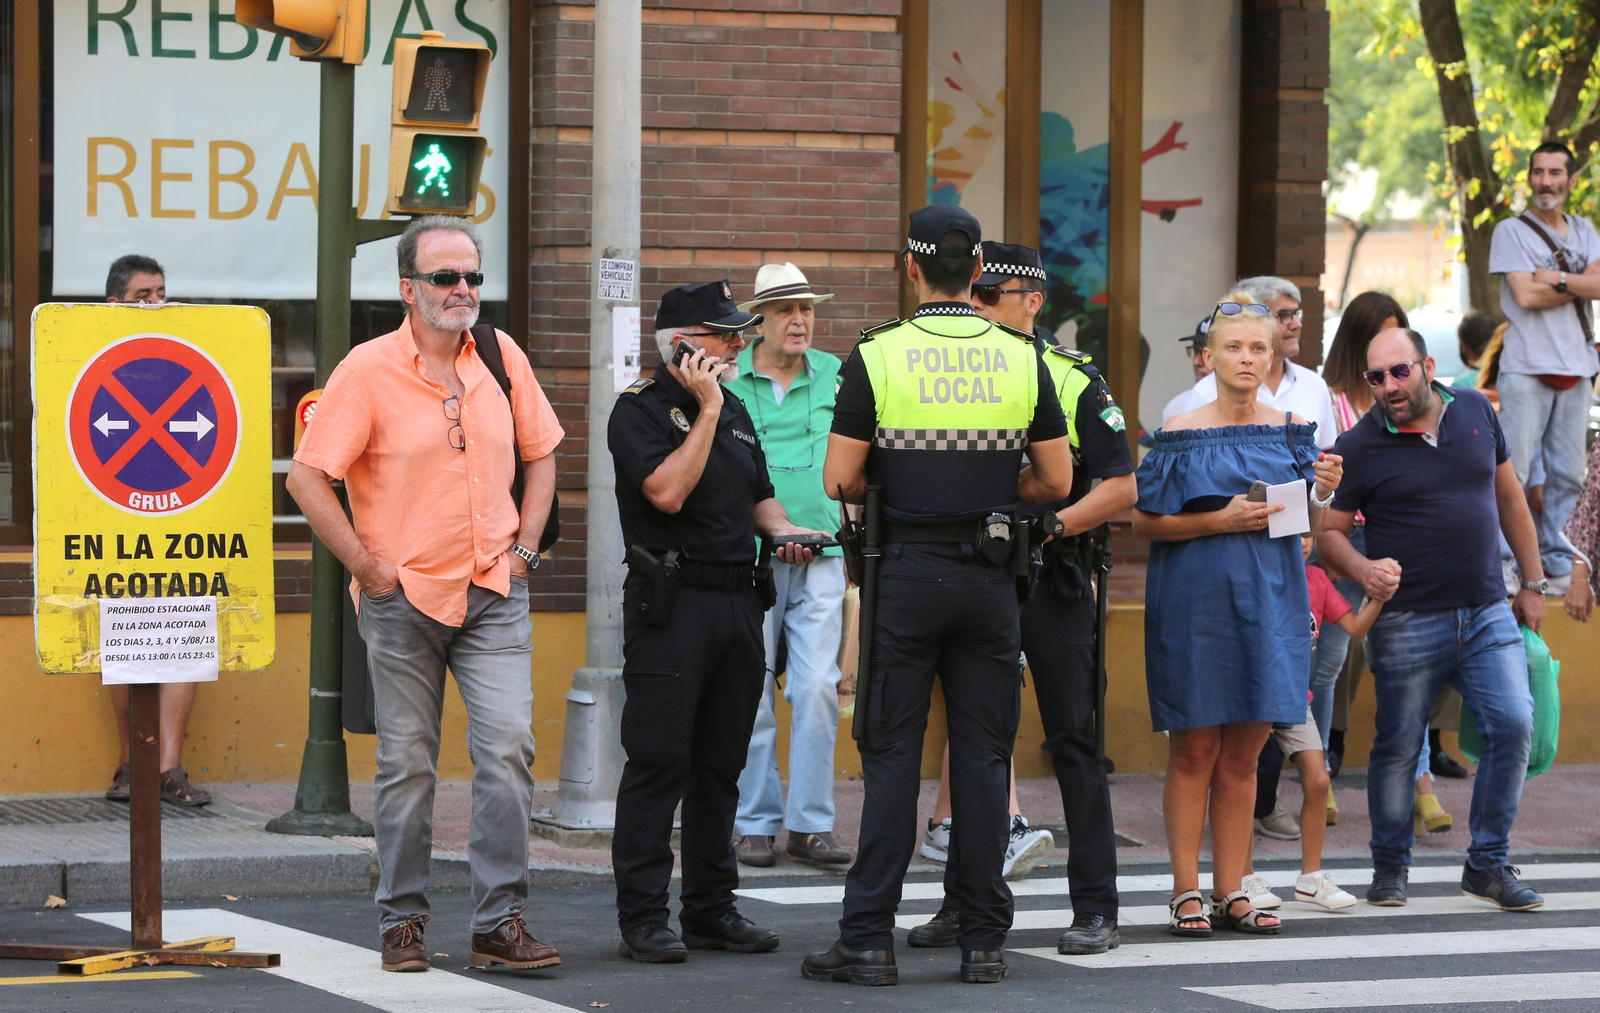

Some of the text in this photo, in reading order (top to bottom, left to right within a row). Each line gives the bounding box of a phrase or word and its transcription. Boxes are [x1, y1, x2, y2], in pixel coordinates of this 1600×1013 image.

[86, 136, 496, 225] REBAJ
[601, 260, 607, 269] SE
[601, 270, 632, 281] VEHICULOS
[906, 347, 1009, 373] POLICIA
[919, 376, 1002, 404] LOCAL
[128, 491, 183, 511] GRUA
[64, 533, 249, 560] EN LA ZONA
[83, 572, 230, 599] ACOTADA
[107, 604, 211, 615] PROHIBIDO ESTACIONAR
[112, 620, 207, 631] EN LA ZONA ACOTADA
[105, 635, 216, 647] LOS DIAS 2, 3, 4 Y 5/08/18
[105, 651, 215, 662] DESDE LAS 13:00 A LAS 23:45
